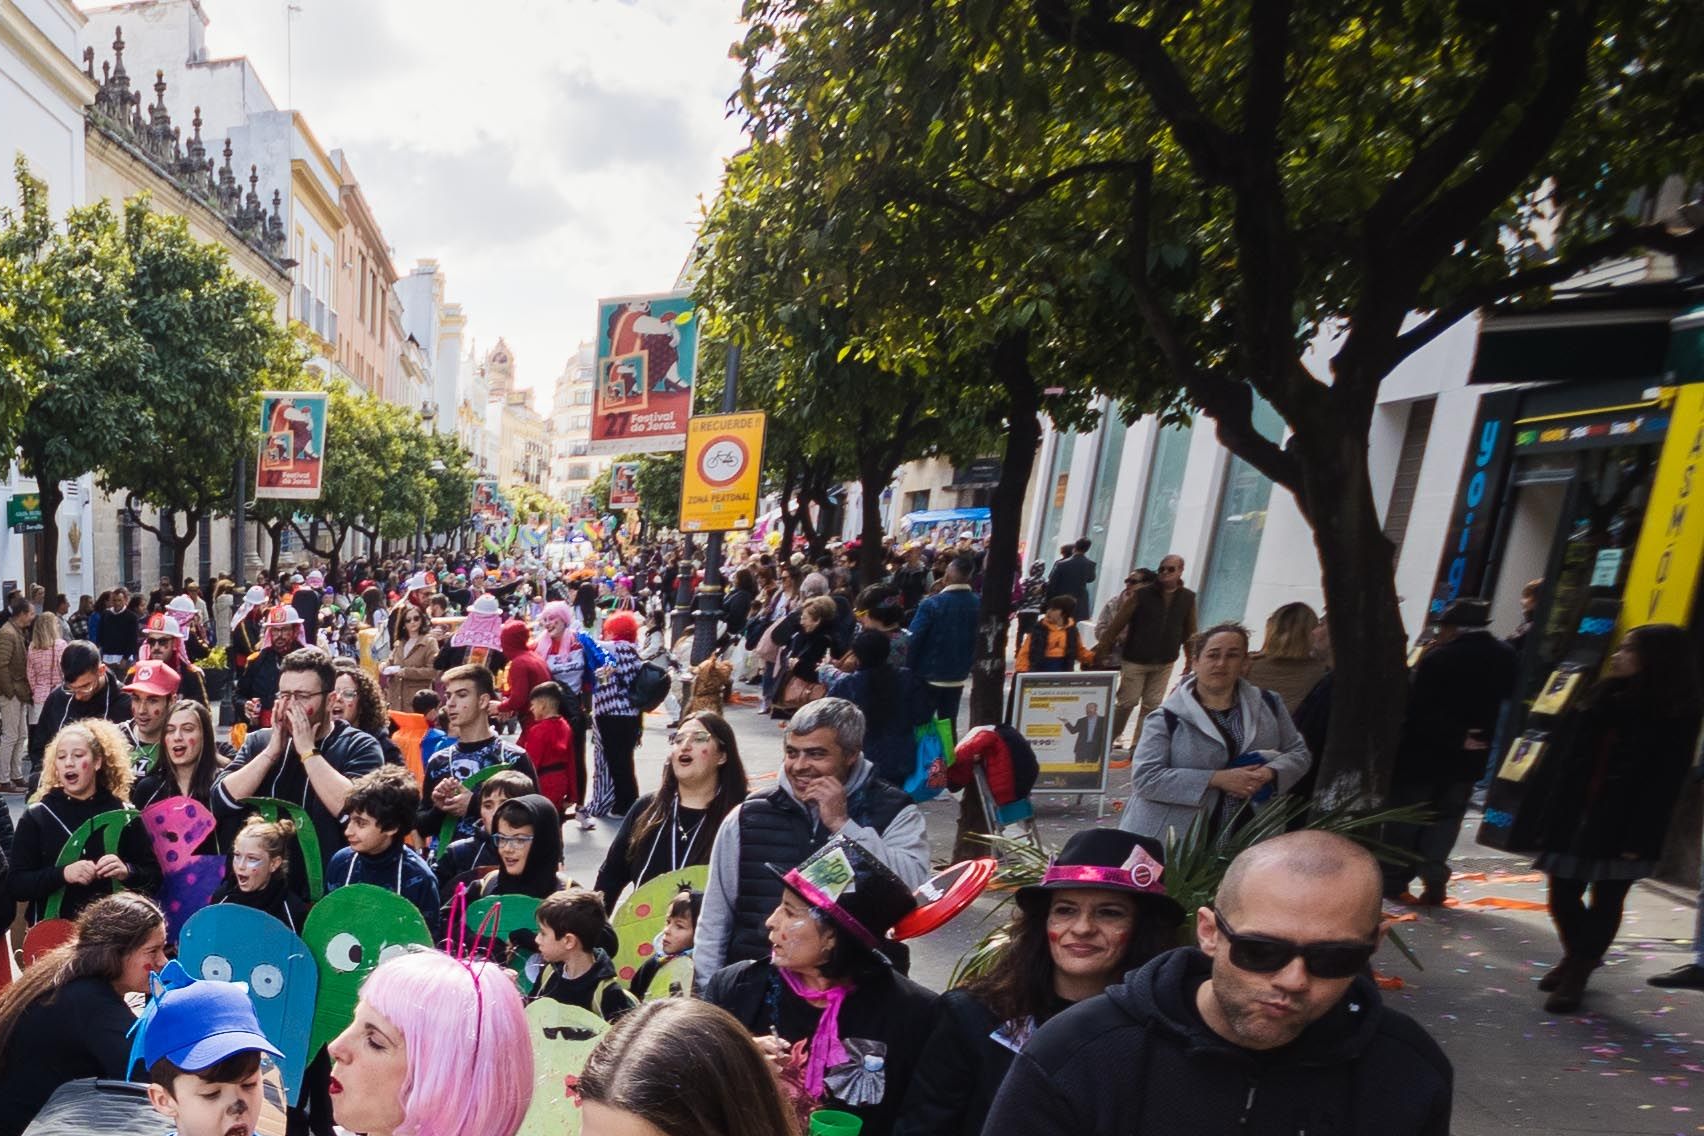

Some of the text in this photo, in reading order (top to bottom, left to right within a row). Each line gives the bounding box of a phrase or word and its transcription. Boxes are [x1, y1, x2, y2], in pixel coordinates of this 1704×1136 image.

[606, 411, 675, 436] 27 Festival
[630, 421, 677, 432] de Jerez
[700, 419, 753, 432] RECUERDE
[828, 857, 849, 885] 100
